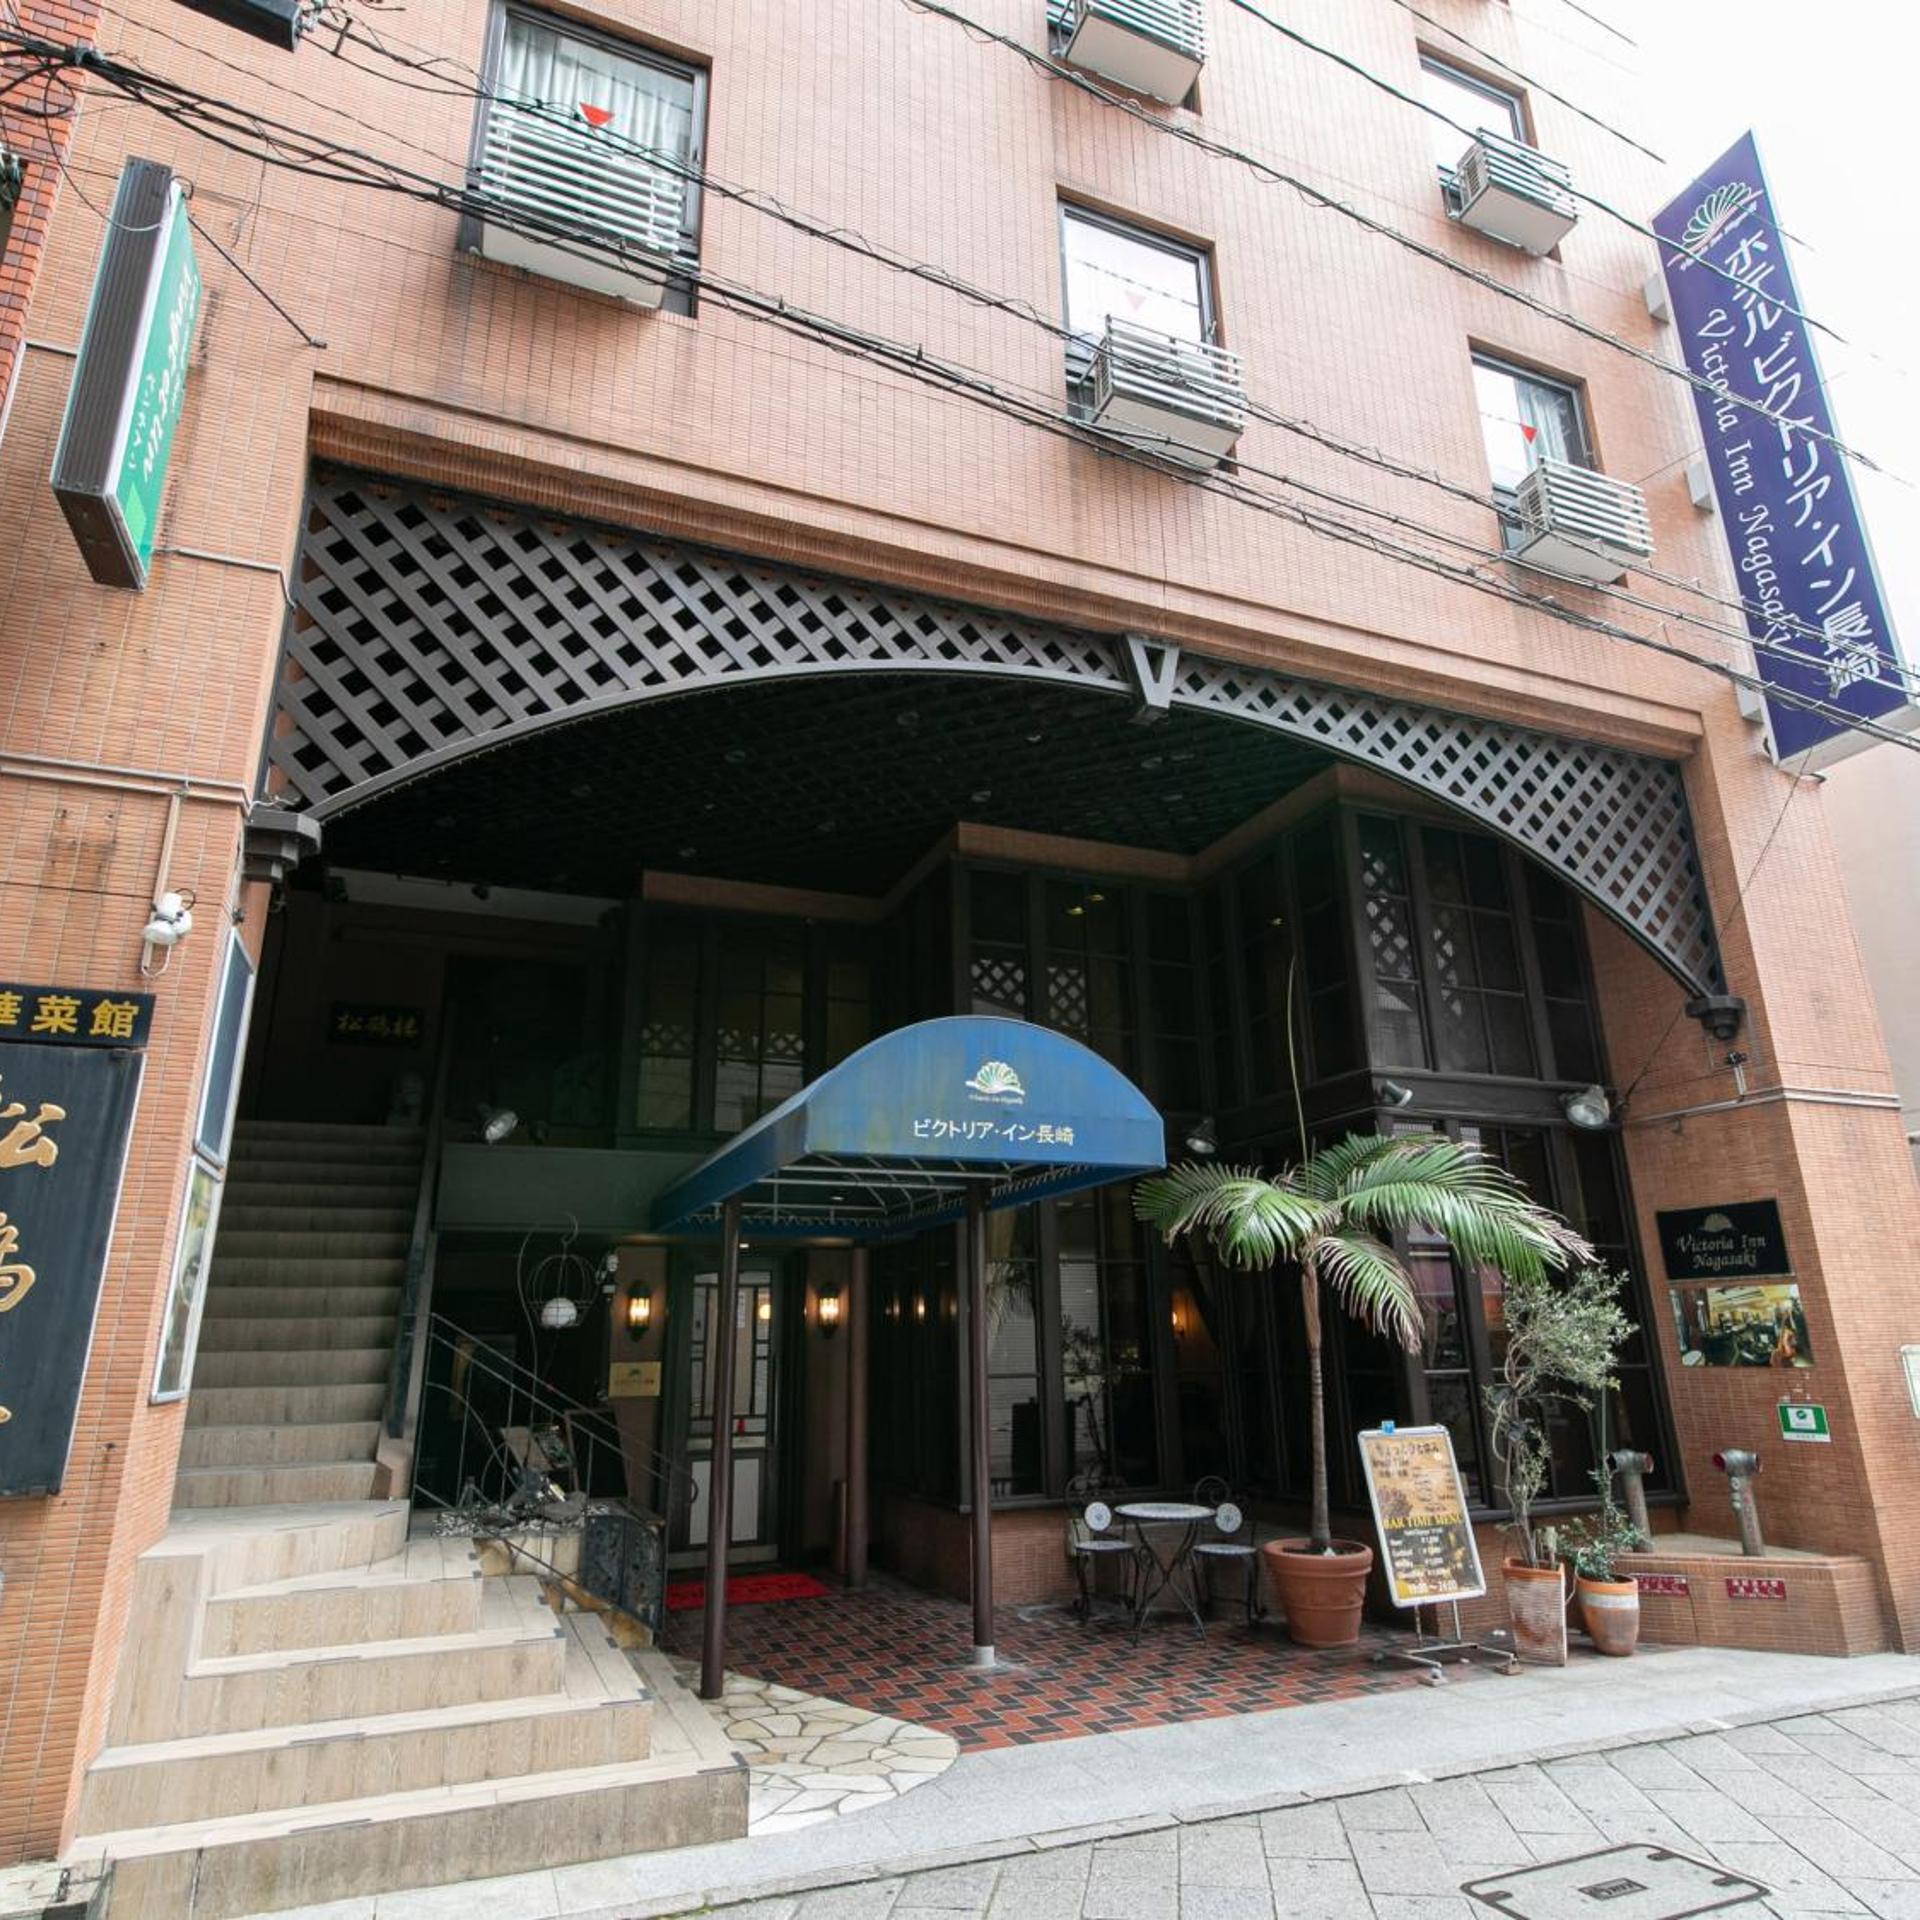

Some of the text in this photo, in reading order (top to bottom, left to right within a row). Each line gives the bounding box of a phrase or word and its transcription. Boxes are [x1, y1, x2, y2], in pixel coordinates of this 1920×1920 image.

[1697, 308, 1738, 433] Victoria
[1724, 439, 1755, 496] Inn
[1738, 504, 1800, 646] Nagasaki
[913, 1118, 1074, 1147] ビクトリア・イン長崎
[1676, 1233, 1767, 1253] Victoria Inn
[1692, 1250, 1757, 1271] Nagasaki
